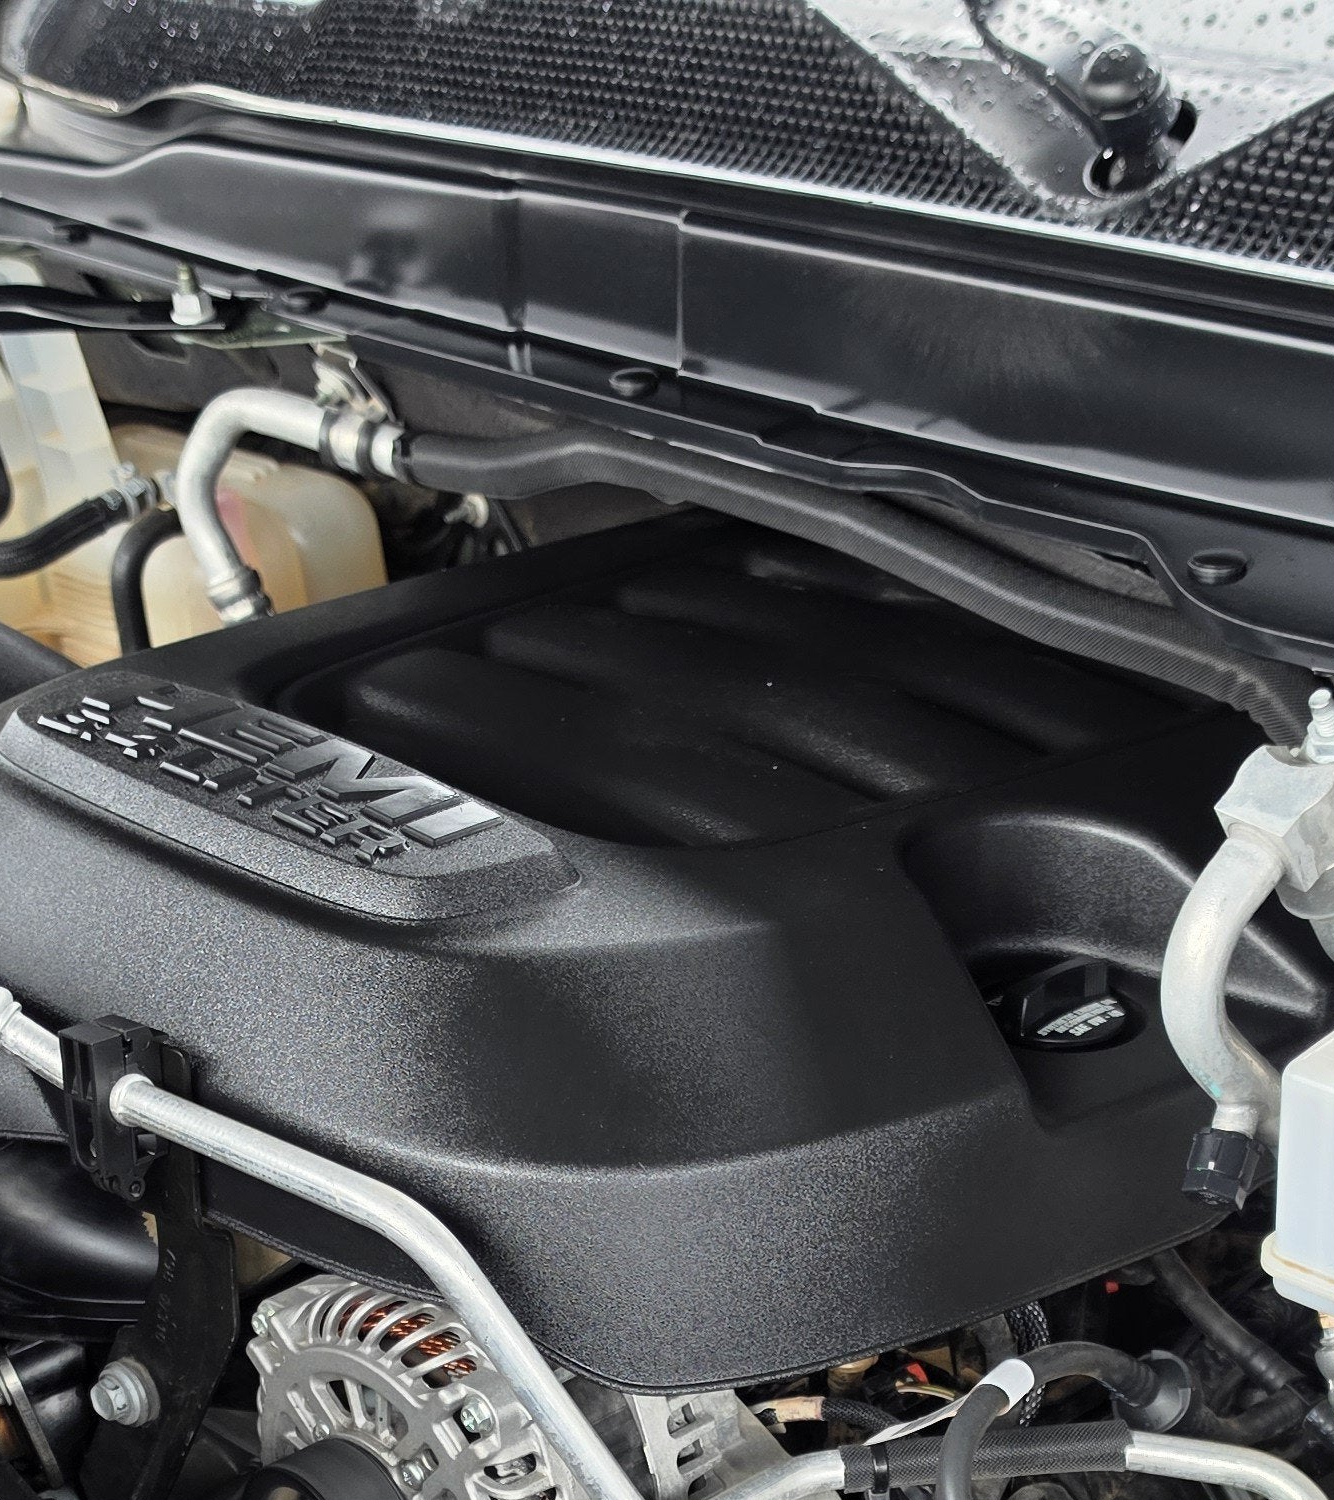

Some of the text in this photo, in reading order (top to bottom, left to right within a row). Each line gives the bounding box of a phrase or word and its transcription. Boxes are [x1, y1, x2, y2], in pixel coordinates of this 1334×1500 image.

[78, 684, 505, 848] HEMI
[158, 746, 413, 867] LITER
[1068, 1022, 1093, 1037] SAE
